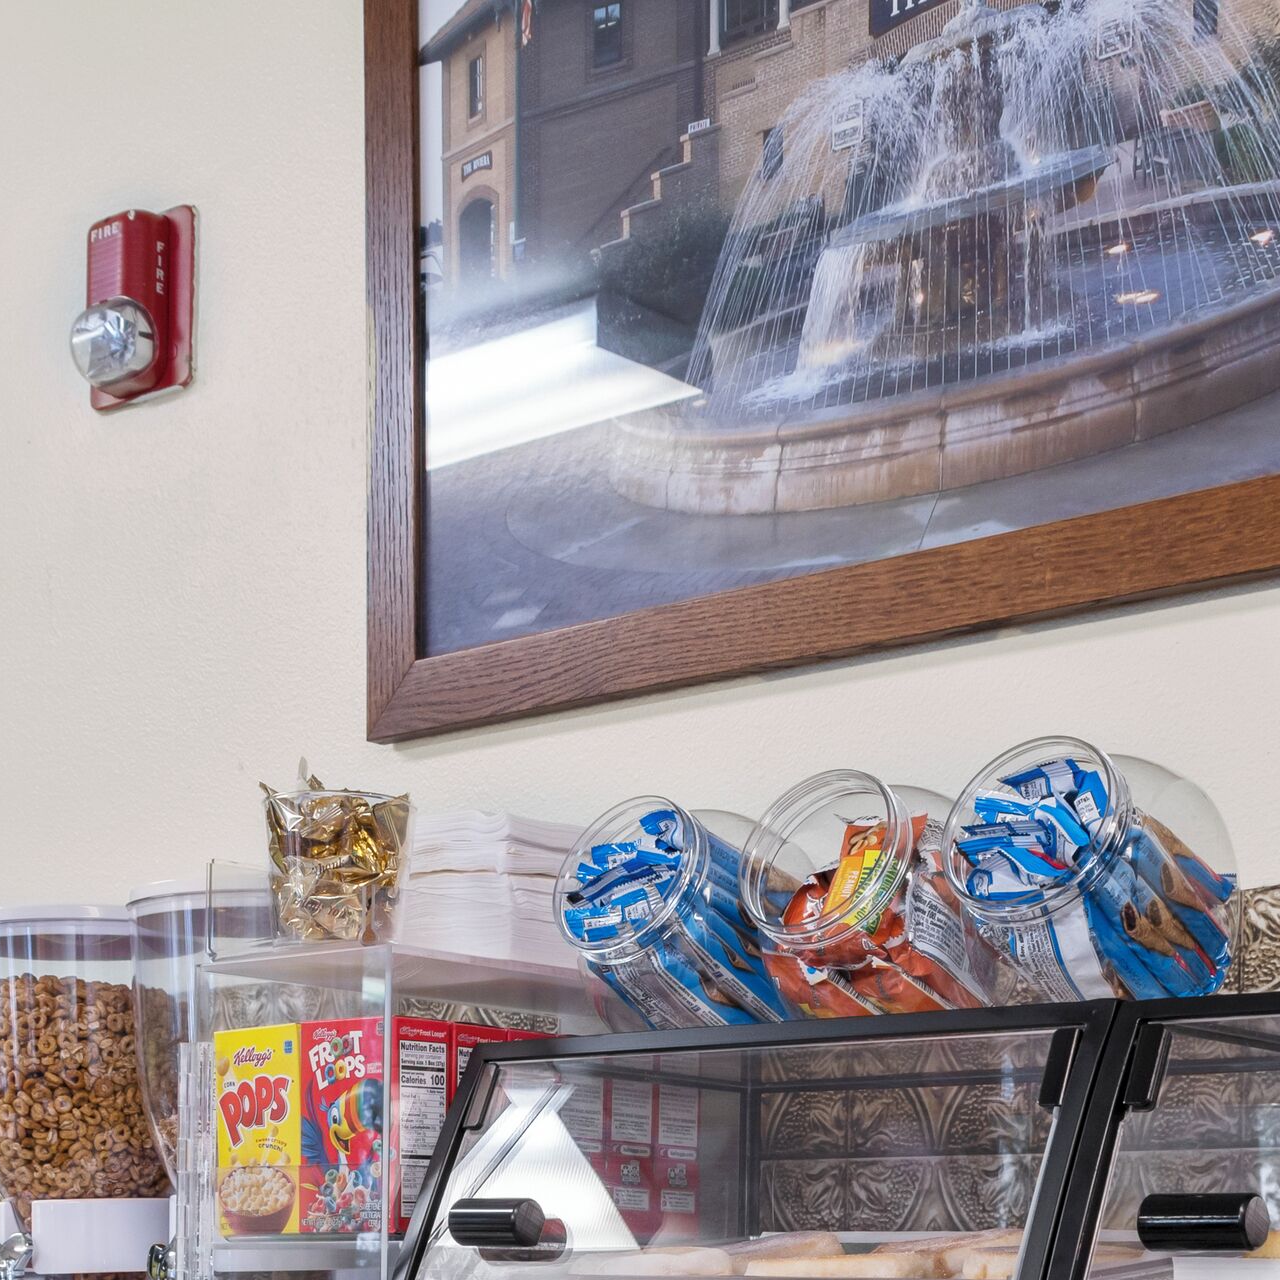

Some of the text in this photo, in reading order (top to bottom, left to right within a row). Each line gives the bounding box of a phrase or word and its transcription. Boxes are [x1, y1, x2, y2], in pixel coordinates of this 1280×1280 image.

[91, 221, 119, 242] FIRE
[156, 241, 165, 295] FIRE
[840, 870, 860, 899] PEANUT
[313, 1028, 337, 1040] Kellogg's
[419, 1029, 431, 1037] Froot
[233, 1046, 273, 1067] Kellogg's
[308, 1031, 363, 1072] FROOT
[401, 1042, 445, 1054] Nutrition Facts
[314, 1055, 365, 1091] LOOPS
[401, 1075, 444, 1086] Calories 100
[224, 1081, 235, 1089] CORN
[219, 1075, 290, 1147] POPS
